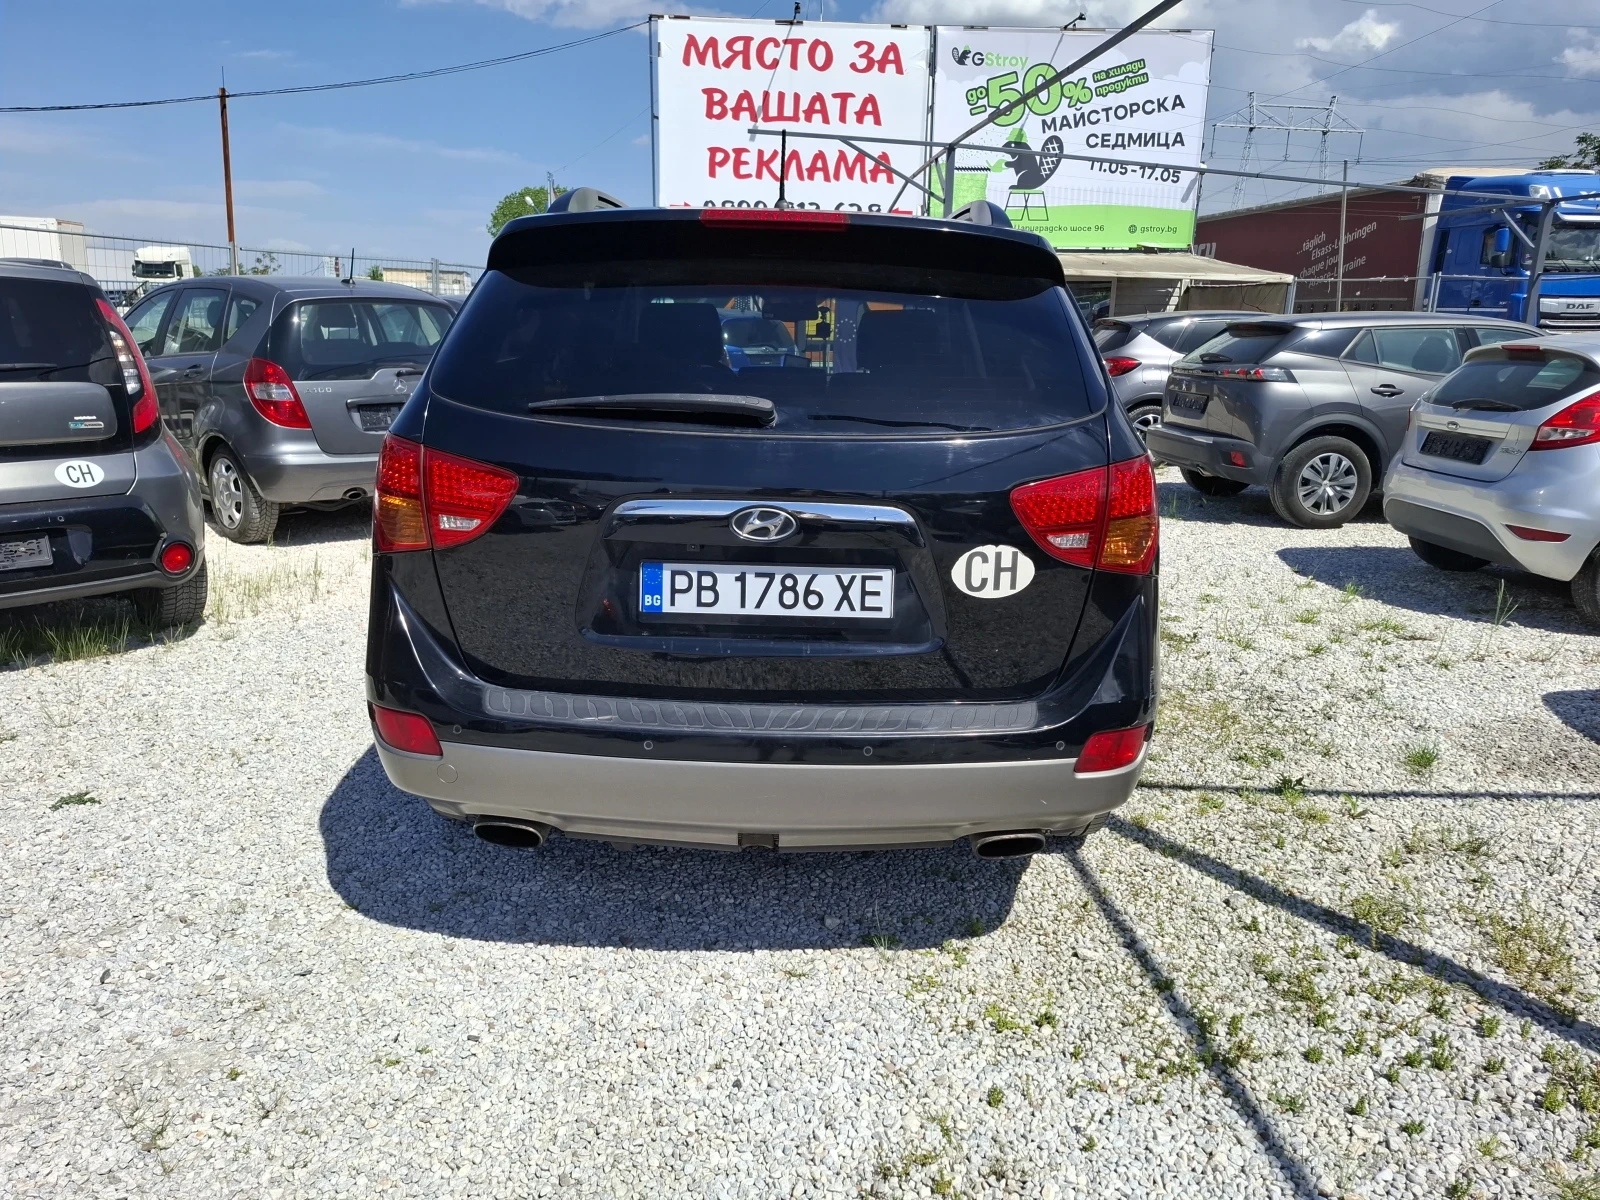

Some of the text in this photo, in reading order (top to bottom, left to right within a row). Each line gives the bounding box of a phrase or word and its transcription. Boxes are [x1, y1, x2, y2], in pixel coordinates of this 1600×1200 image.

[682, 33, 904, 75] МЯСТО ЗА
[972, 51, 1029, 70] GStroy
[1093, 59, 1146, 83] на хиляди
[966, 86, 987, 106] до
[1095, 73, 1149, 97] продукти
[701, 87, 882, 126] ВАШАТА
[1041, 94, 1186, 134] МАЙСТОРСКА
[1086, 132, 1185, 150] СЕДМИЦА
[707, 146, 894, 184] РЕКЛАМА
[1094, 224, 1105, 232] 96
[1140, 224, 1178, 234] gstroy.bg
[66, 464, 95, 483] CH
[964, 550, 1018, 593] CH
[644, 594, 661, 607] BG
[669, 569, 884, 612] PB 1786 XE
